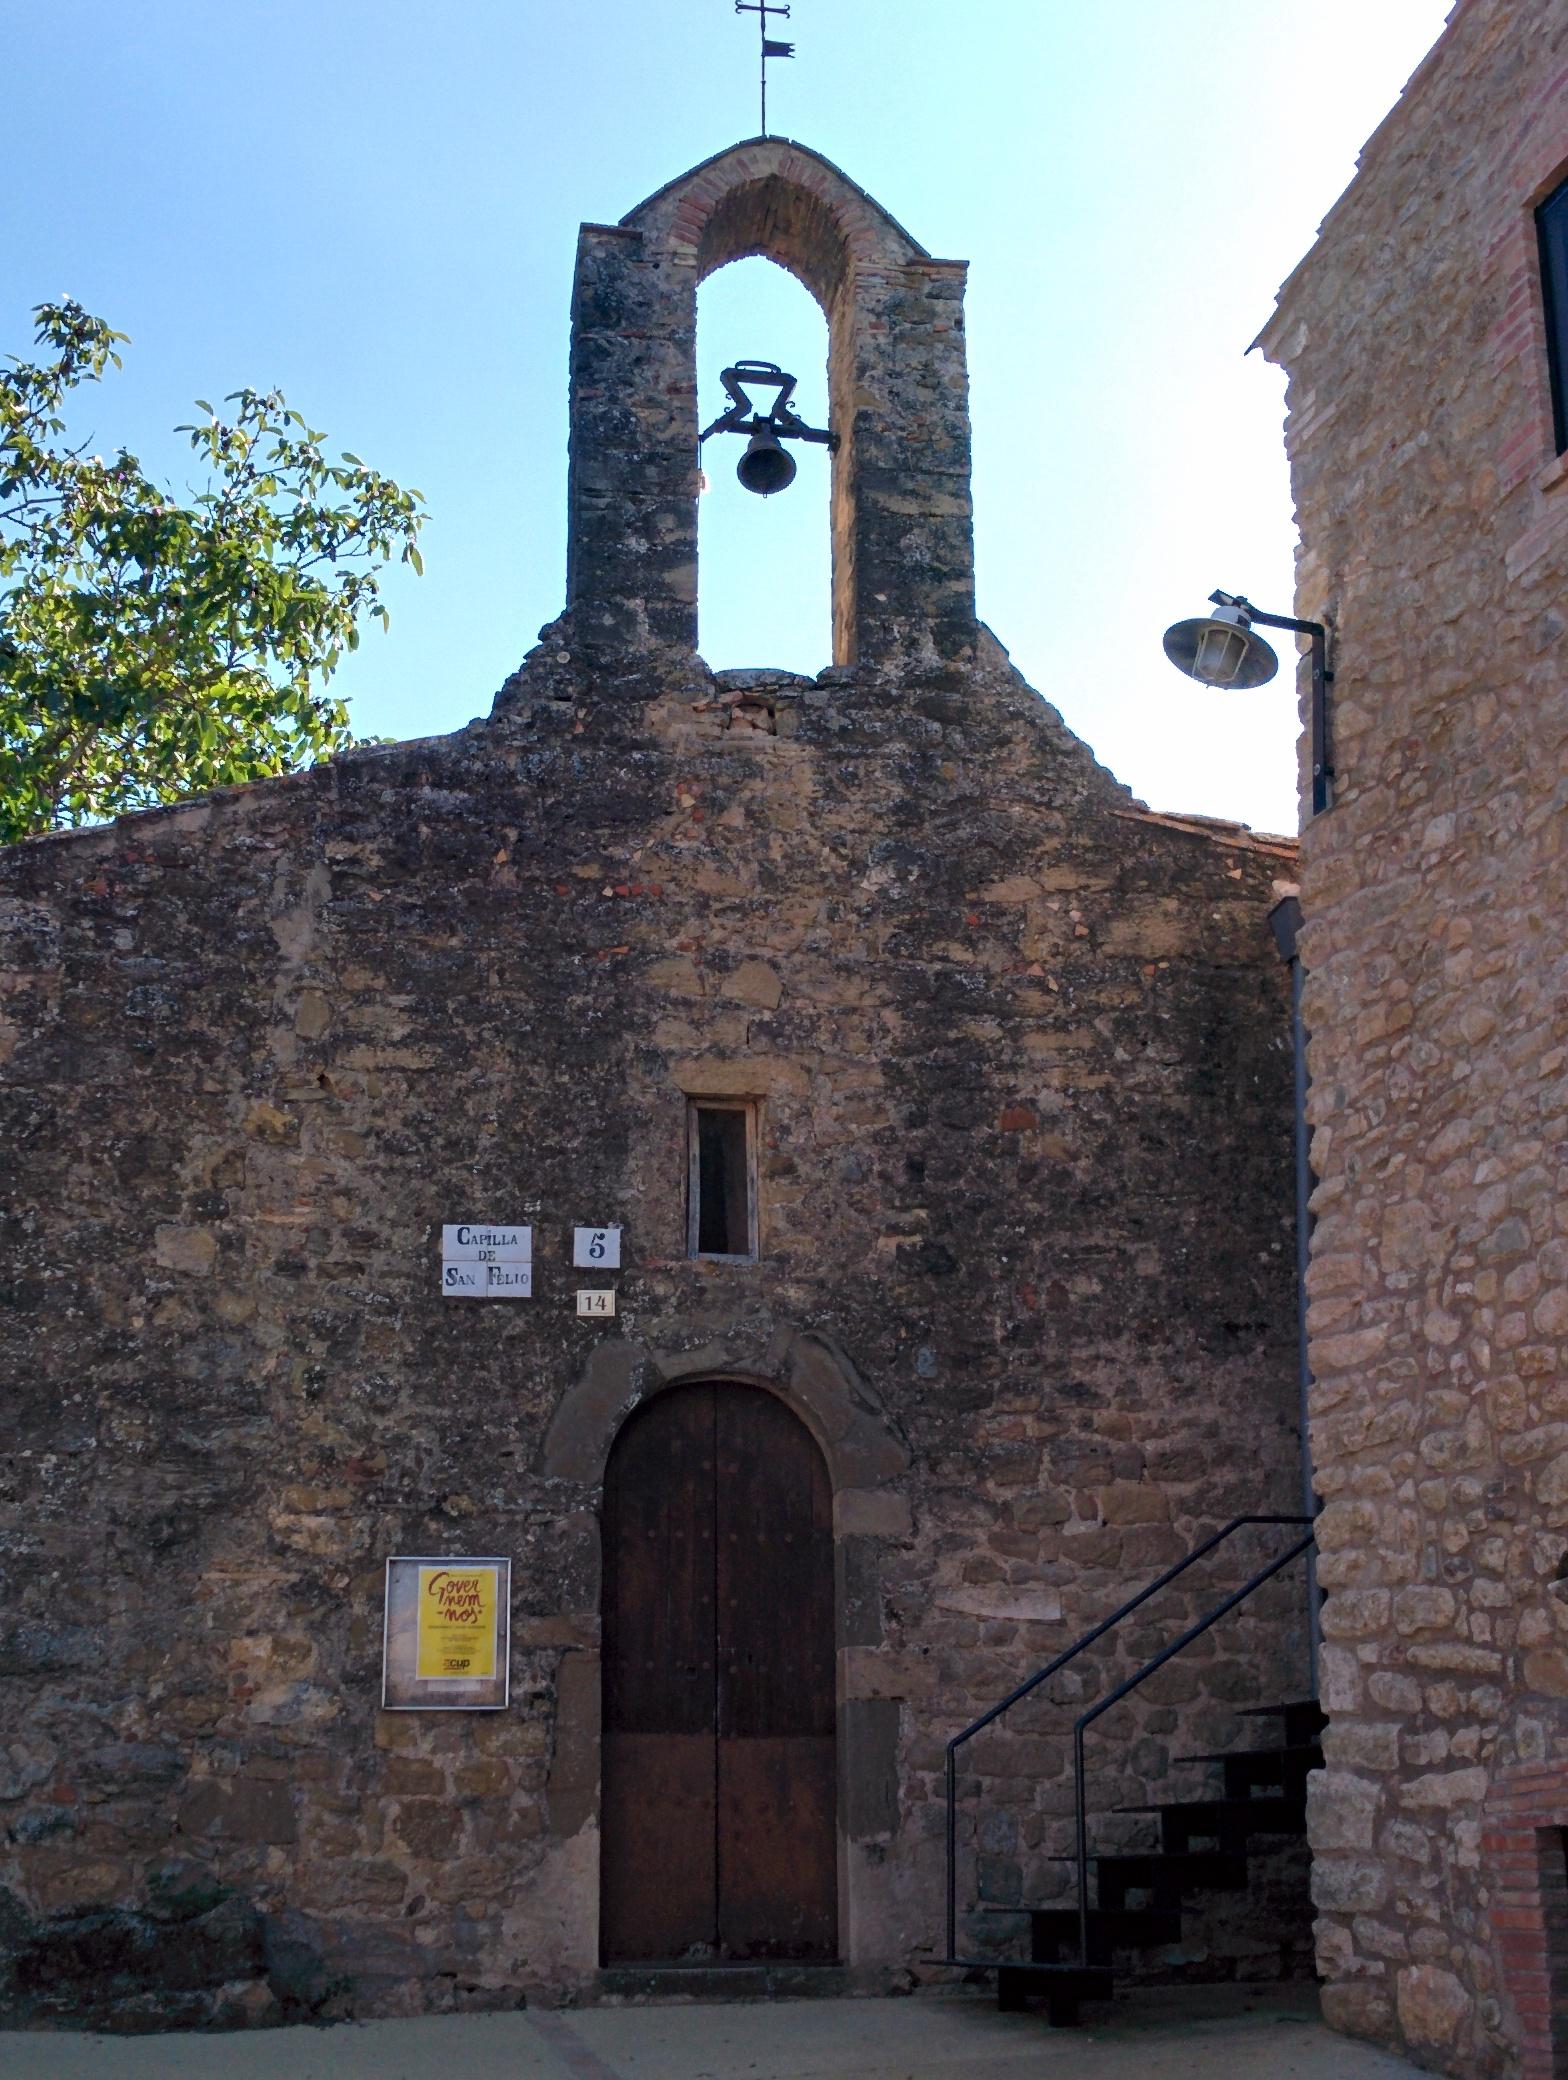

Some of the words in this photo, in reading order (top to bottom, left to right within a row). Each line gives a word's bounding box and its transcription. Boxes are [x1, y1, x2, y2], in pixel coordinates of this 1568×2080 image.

[457, 1226, 518, 1246] CAPILLA
[589, 1232, 606, 1259] 5
[478, 1250, 496, 1262] DE
[445, 1267, 476, 1286] SAN
[487, 1266, 529, 1286] FELIO
[584, 1295, 607, 1311] 14
